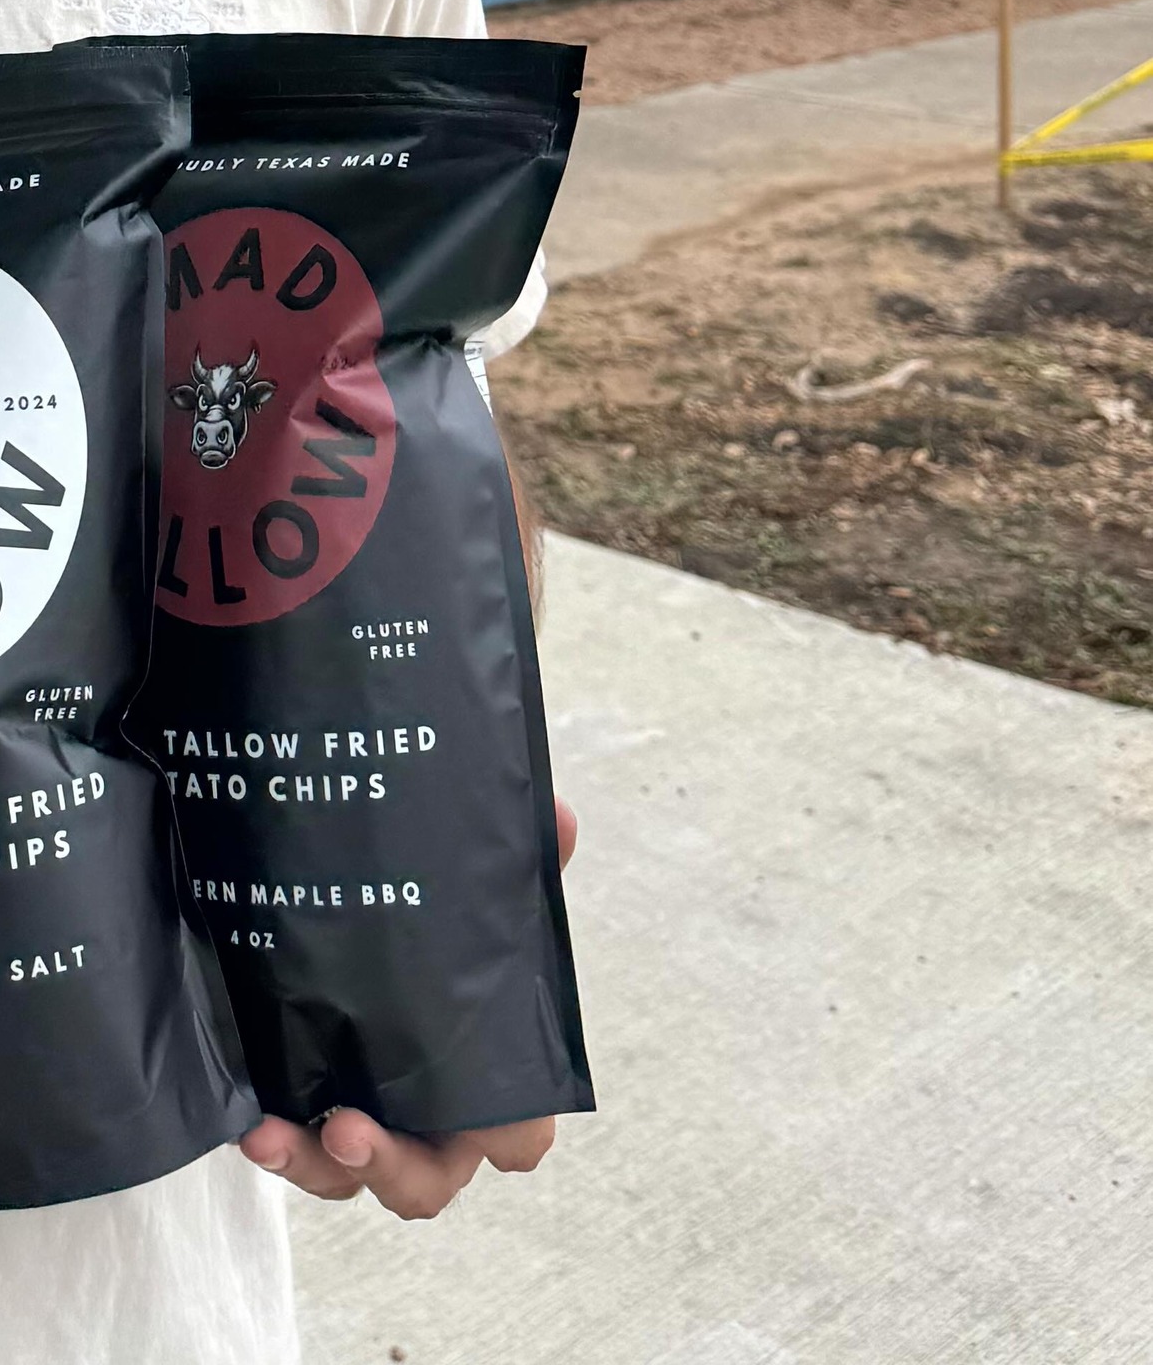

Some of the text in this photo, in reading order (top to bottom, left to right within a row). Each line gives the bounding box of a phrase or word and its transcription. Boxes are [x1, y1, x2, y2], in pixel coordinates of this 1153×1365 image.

[178, 152, 410, 172] UDLY TEXAS MADE
[163, 227, 337, 312] MAD
[3, 394, 58, 412] 2024
[157, 398, 377, 605] LLOW
[351, 619, 429, 640] GLUTEN
[370, 642, 417, 660] FREE
[25, 685, 93, 703] GLUTEN
[34, 707, 78, 722] FREE
[163, 726, 436, 759] TALLOW FRIED
[7, 772, 106, 824] FRIED
[167, 771, 387, 802] TATO CHIPS
[250, 883, 343, 906] MAPLE
[361, 881, 421, 906] BBQ
[230, 930, 275, 949] 4 OZ
[9, 944, 85, 982] SALT
